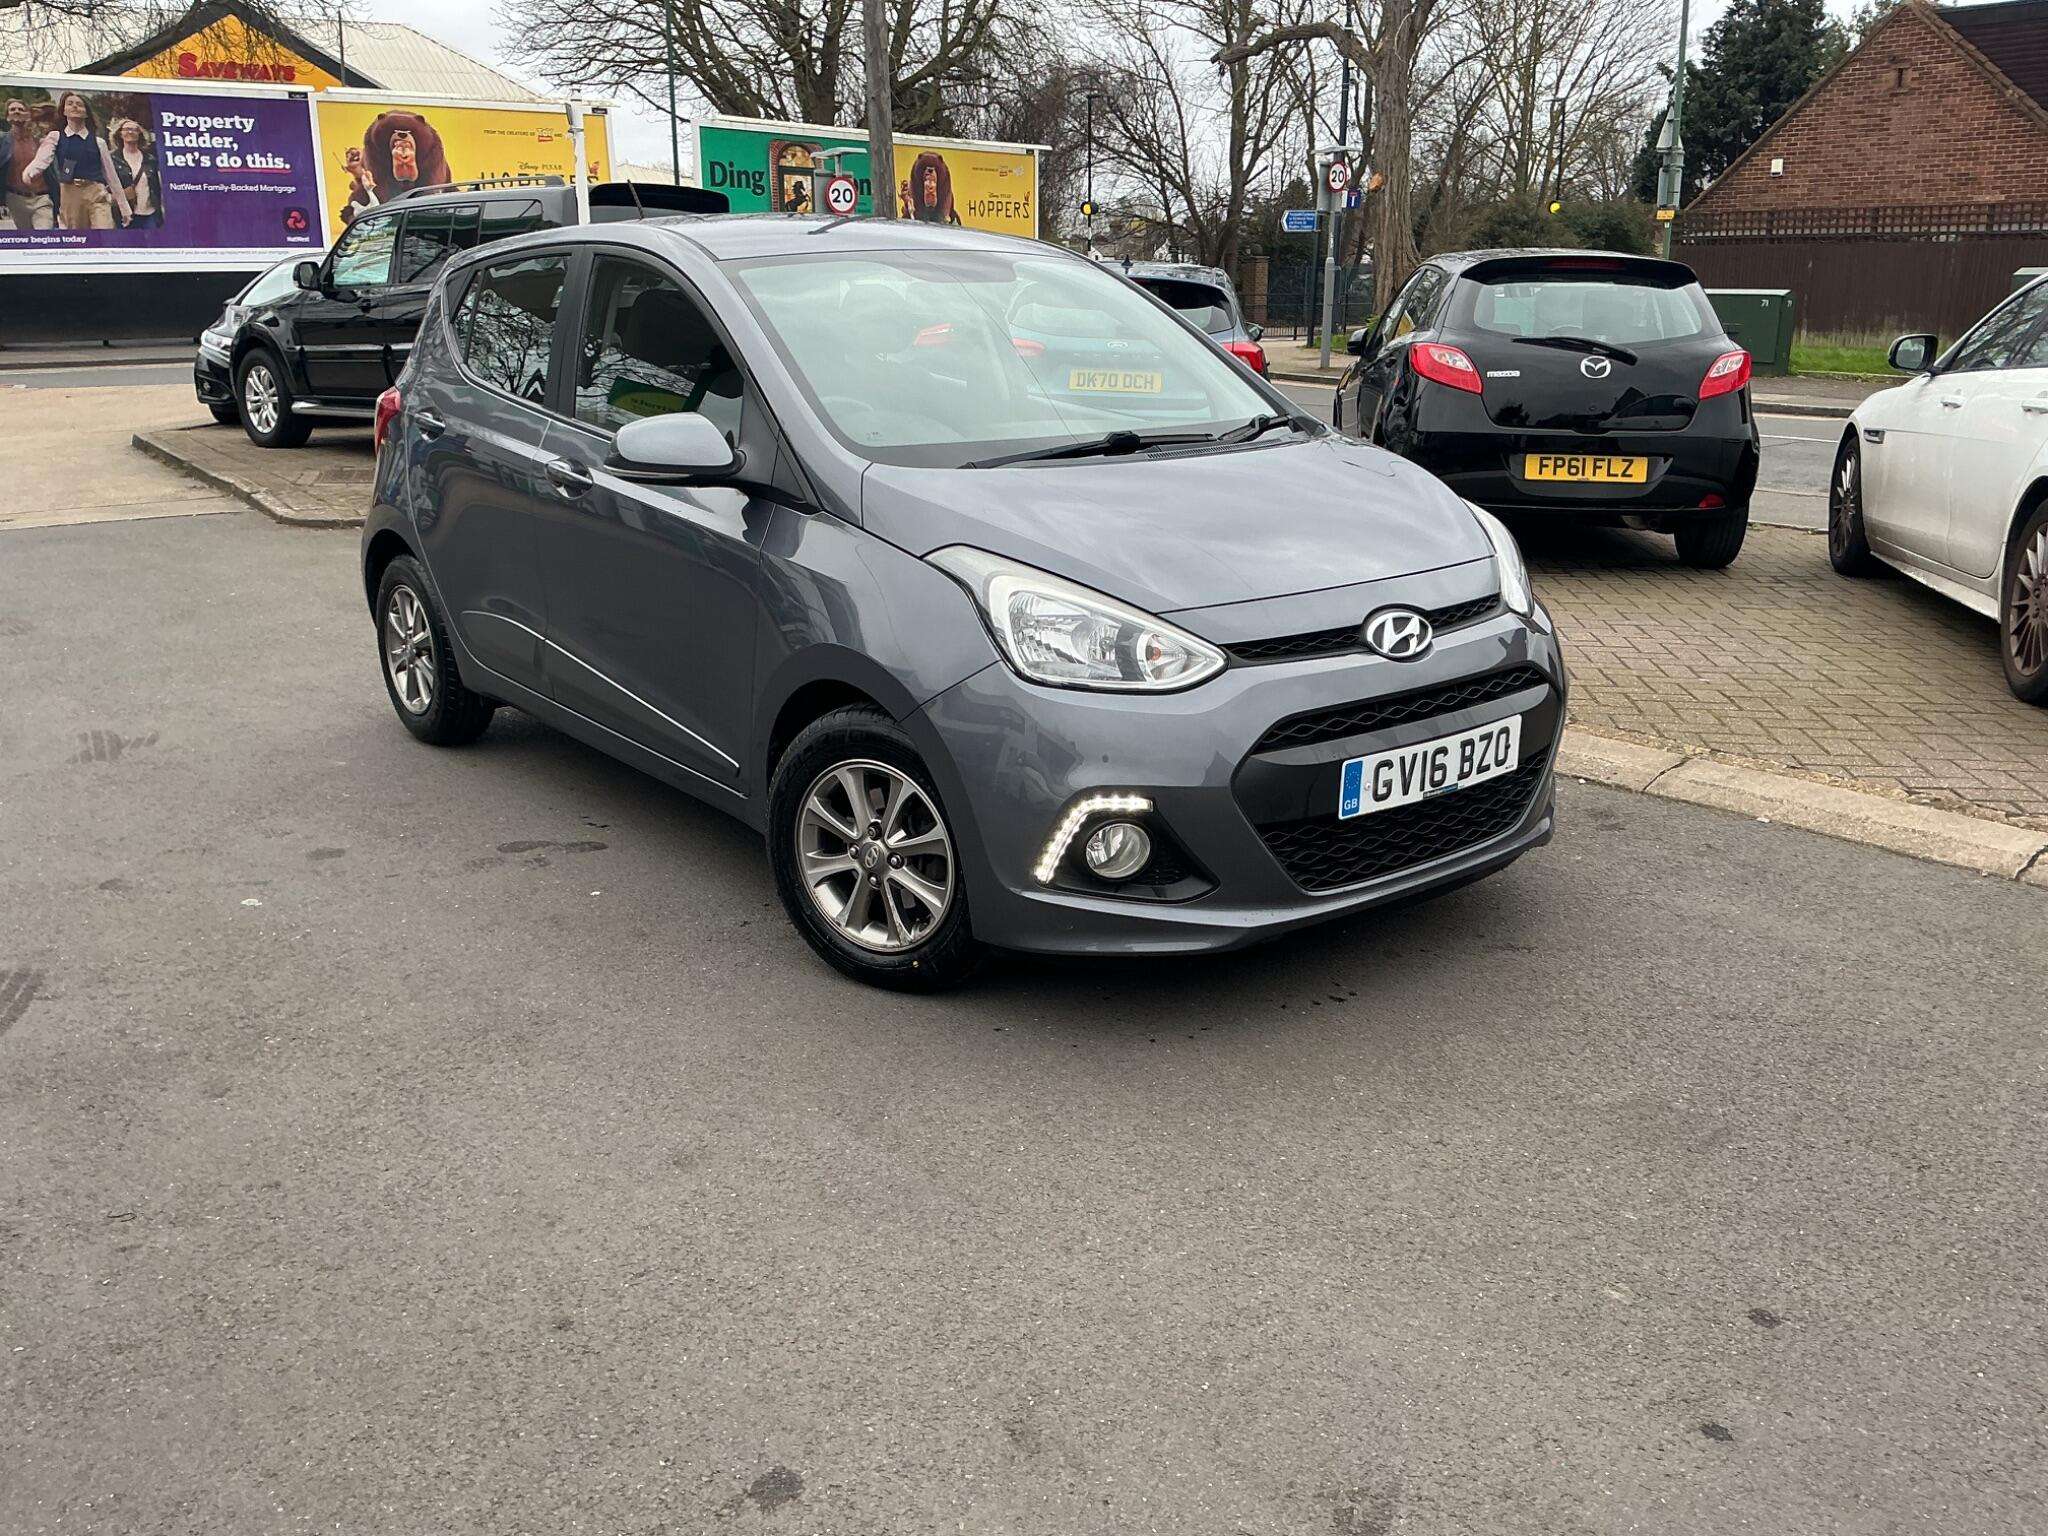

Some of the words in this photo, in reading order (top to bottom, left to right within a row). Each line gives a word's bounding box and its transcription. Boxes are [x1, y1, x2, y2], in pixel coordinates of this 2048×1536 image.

[160, 112, 255, 133] Property
[163, 132, 239, 152] ladder,
[165, 151, 211, 167] let's
[215, 153, 242, 168] do
[245, 153, 291, 169] this.
[709, 161, 766, 196] Ding
[1331, 170, 1345, 183] 20
[169, 183, 202, 191] NatWest
[203, 184, 259, 193] Family-Backed
[260, 184, 297, 194] Mortgage
[831, 188, 853, 204] 20
[968, 200, 1030, 219] HOPPERS
[30, 236, 61, 244] begins
[62, 236, 88, 244] today
[1076, 372, 1118, 388] DK70
[1538, 456, 1586, 477] FP61
[1592, 458, 1634, 478] FLZ
[1371, 746, 1449, 803] GV16
[1457, 726, 1511, 781] BZO
[1343, 798, 1358, 810] GB
